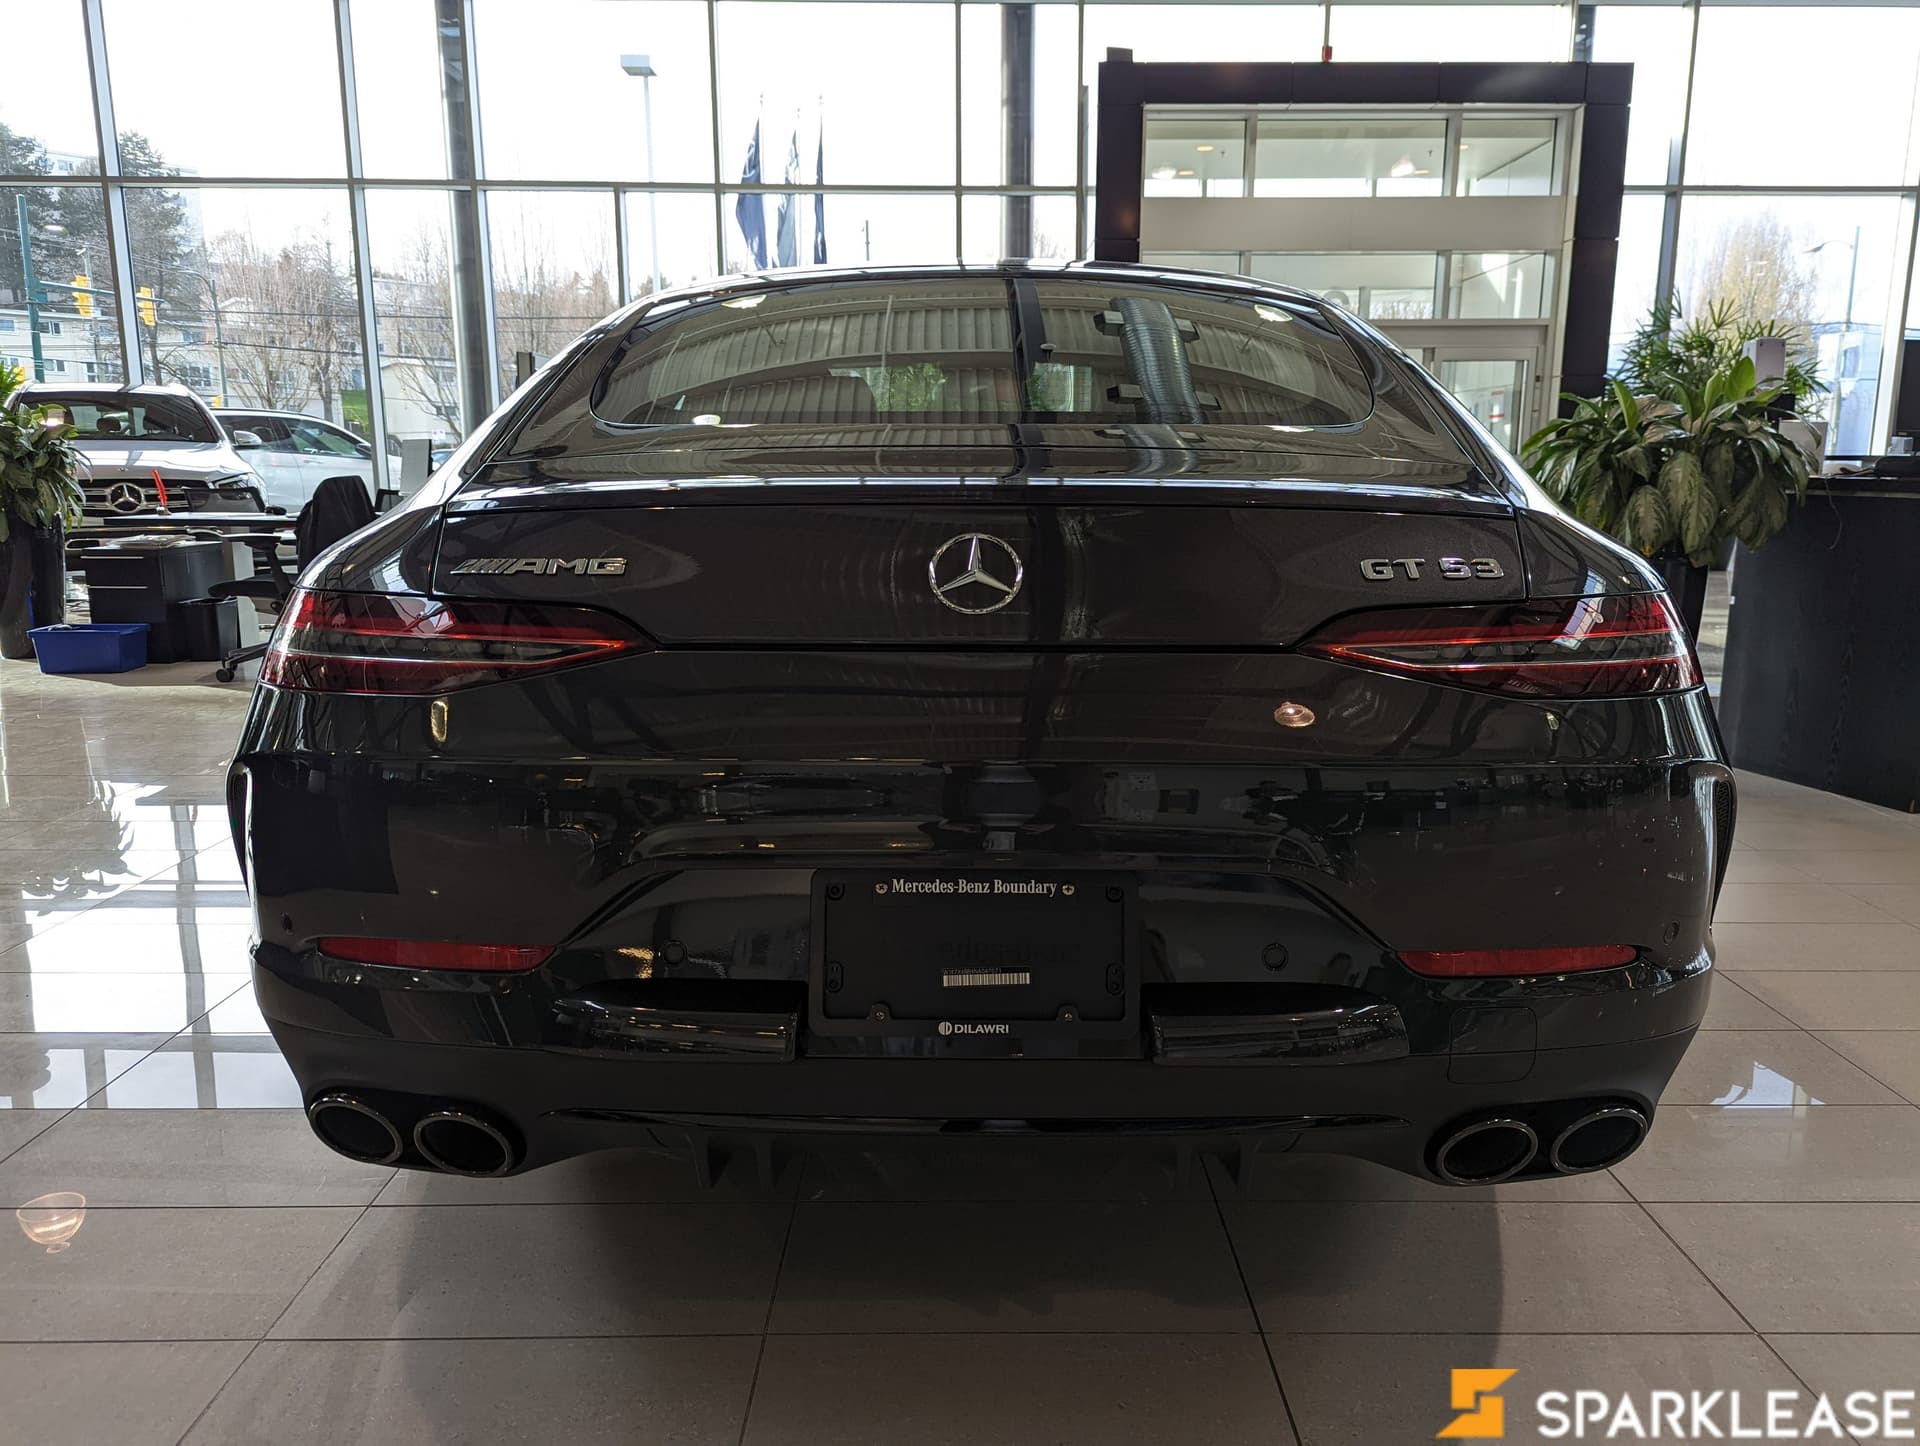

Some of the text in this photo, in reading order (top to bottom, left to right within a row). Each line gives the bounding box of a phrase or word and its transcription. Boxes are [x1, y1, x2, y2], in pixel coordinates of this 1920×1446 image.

[503, 558, 627, 575] AMG
[1360, 557, 1505, 580] GT 53
[891, 878, 1058, 897] Mercedes-Benz Boundary
[954, 1023, 1010, 1035] DILAWRI
